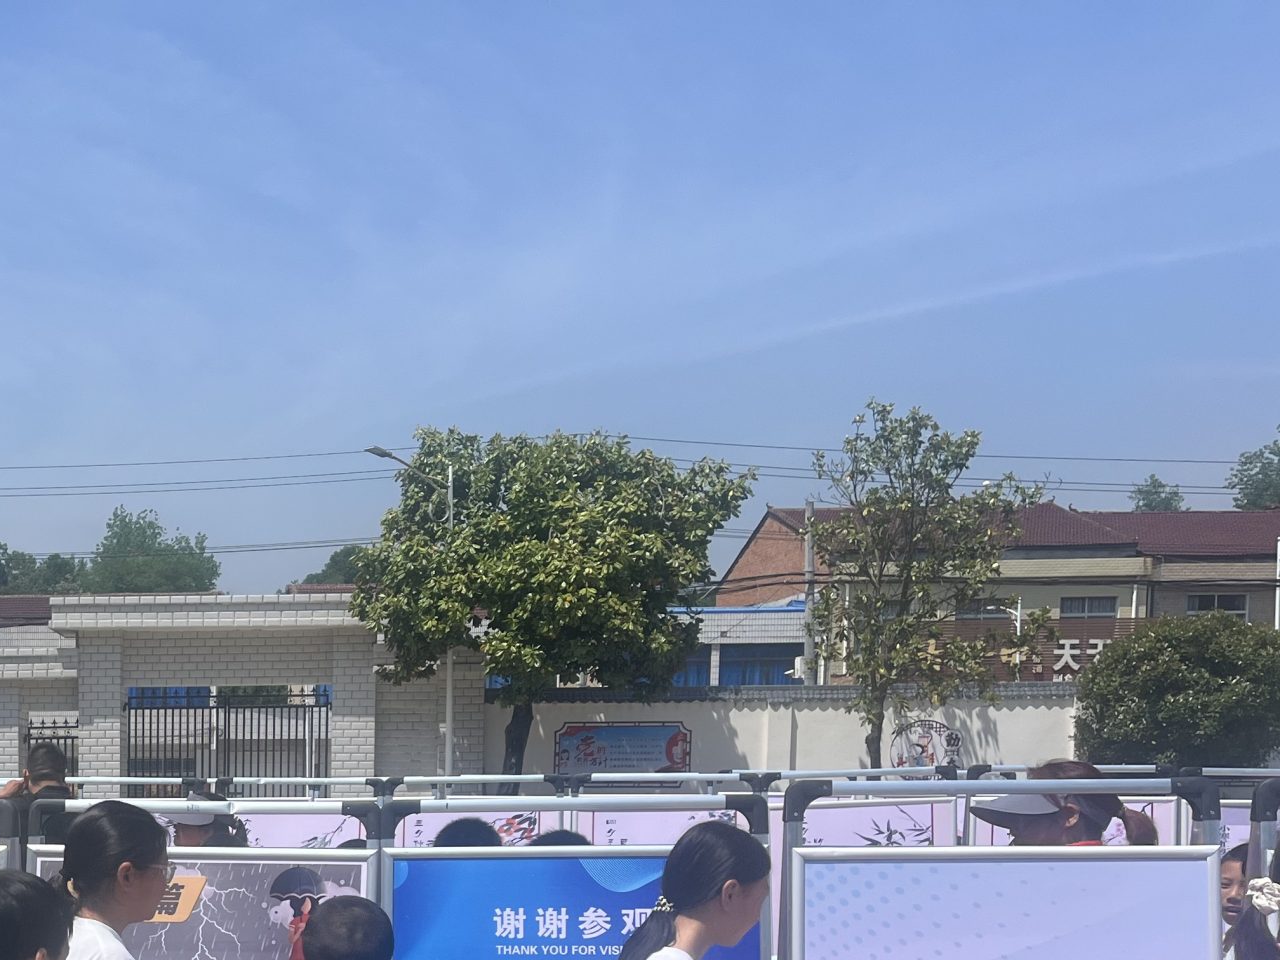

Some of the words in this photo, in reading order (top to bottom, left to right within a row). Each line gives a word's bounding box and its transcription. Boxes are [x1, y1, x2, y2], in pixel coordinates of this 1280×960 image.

[493, 907, 652, 940] 谢谢参观
[496, 945, 538, 956] THANK
[541, 945, 569, 956] YOU
[571, 945, 597, 956] FOR
